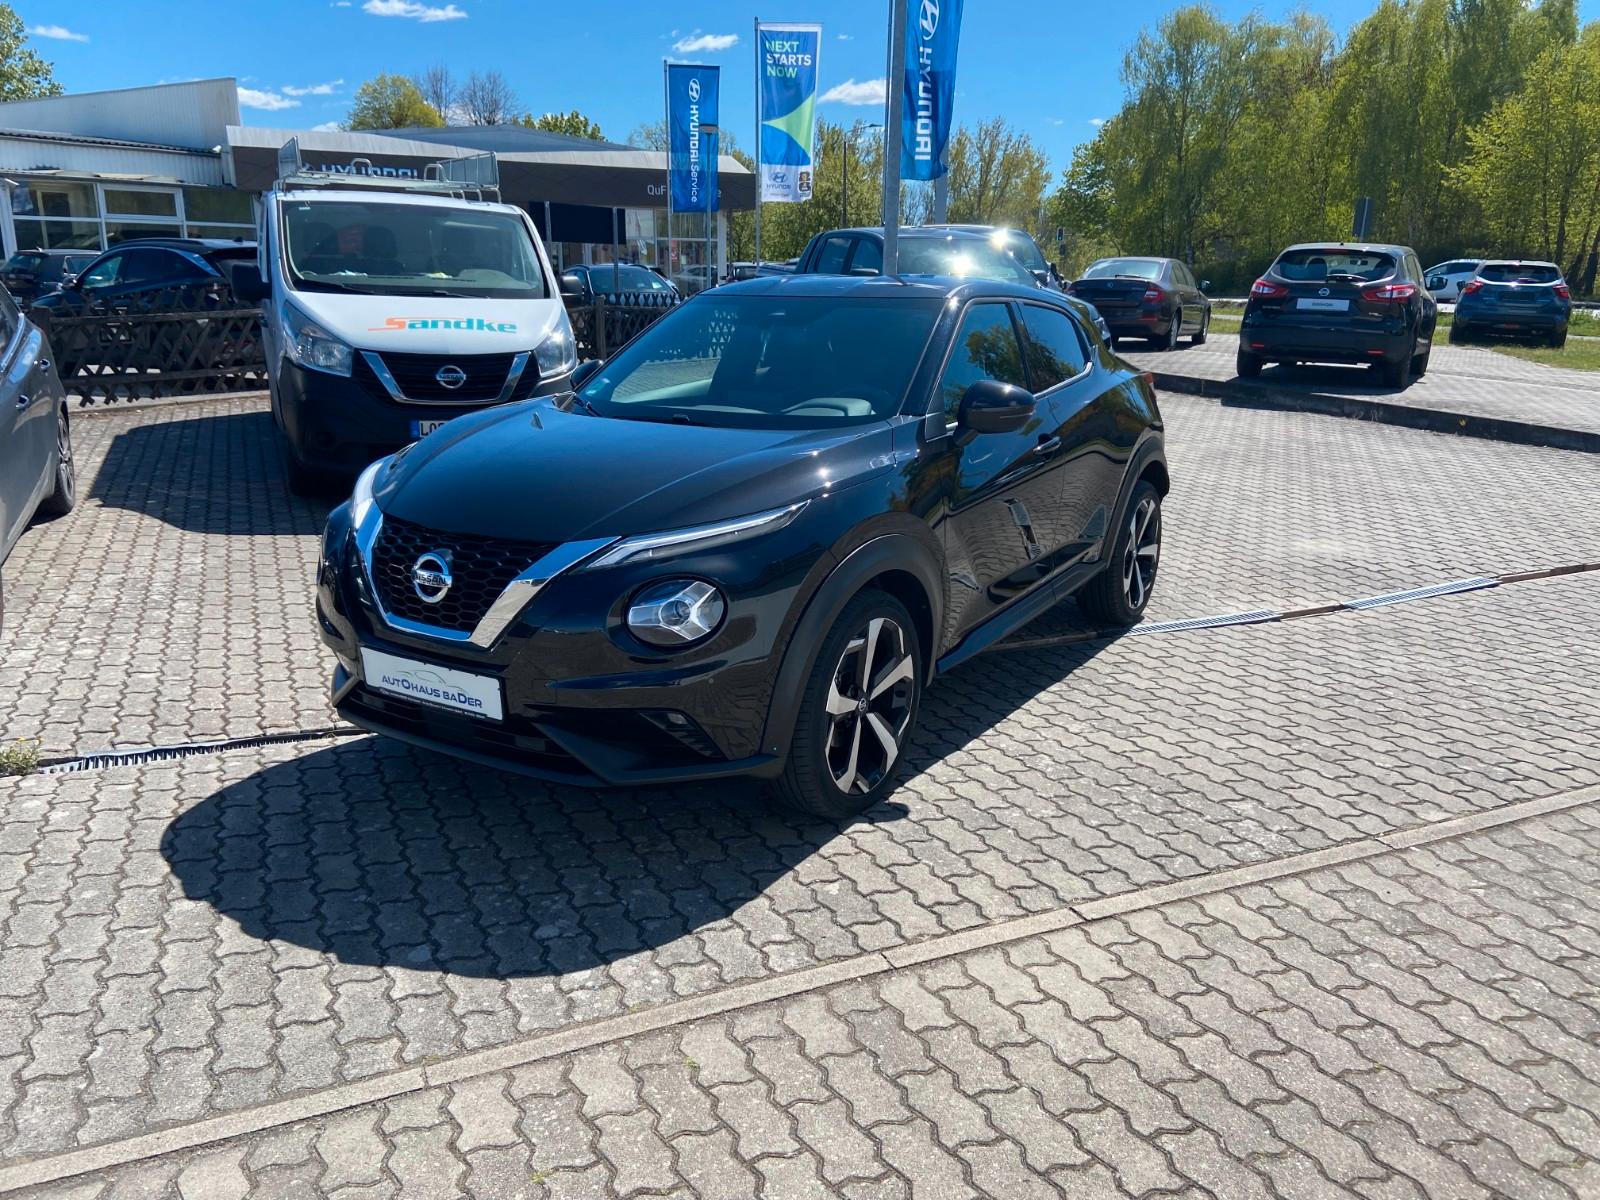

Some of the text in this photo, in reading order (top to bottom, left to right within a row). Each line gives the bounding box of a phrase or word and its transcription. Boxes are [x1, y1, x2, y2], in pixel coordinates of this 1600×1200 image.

[765, 40, 799, 53] NEXT
[766, 53, 812, 66] STARTS
[767, 65, 798, 79] NOW
[914, 46, 933, 161] HYUNDAI
[689, 104, 700, 203] HYUNDAI Service
[647, 184, 668, 196] QuF
[376, 317, 518, 334] Sandke
[420, 422, 446, 437] LO
[381, 674, 441, 698] AUTOHAUS
[442, 691, 483, 709] BADER
